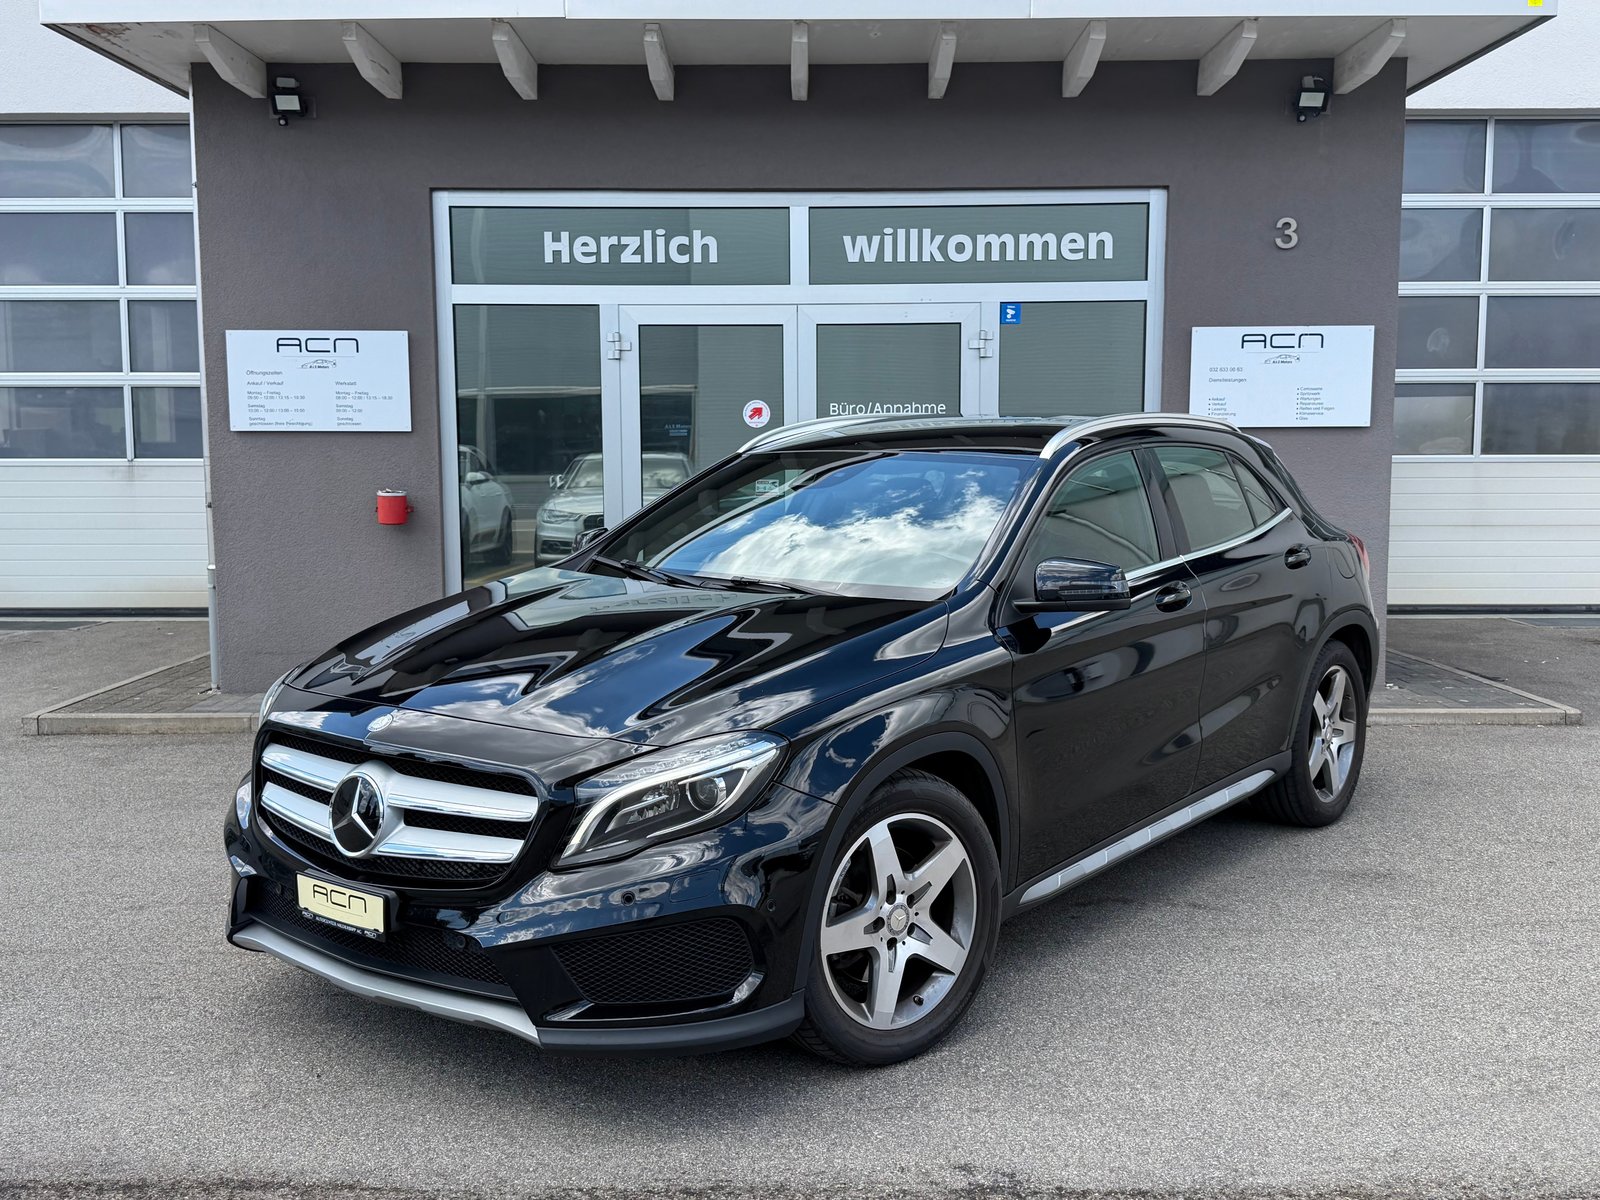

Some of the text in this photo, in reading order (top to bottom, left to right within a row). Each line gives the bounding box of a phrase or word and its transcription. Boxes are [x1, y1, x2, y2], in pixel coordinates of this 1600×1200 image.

[1275, 217, 1298, 249] 3
[543, 227, 1114, 264] Herzlich willkommen
[276, 337, 359, 353] ACN
[1241, 333, 1324, 349] ACN
[829, 402, 946, 415] Büro/Annahme
[313, 884, 367, 914] ACN
